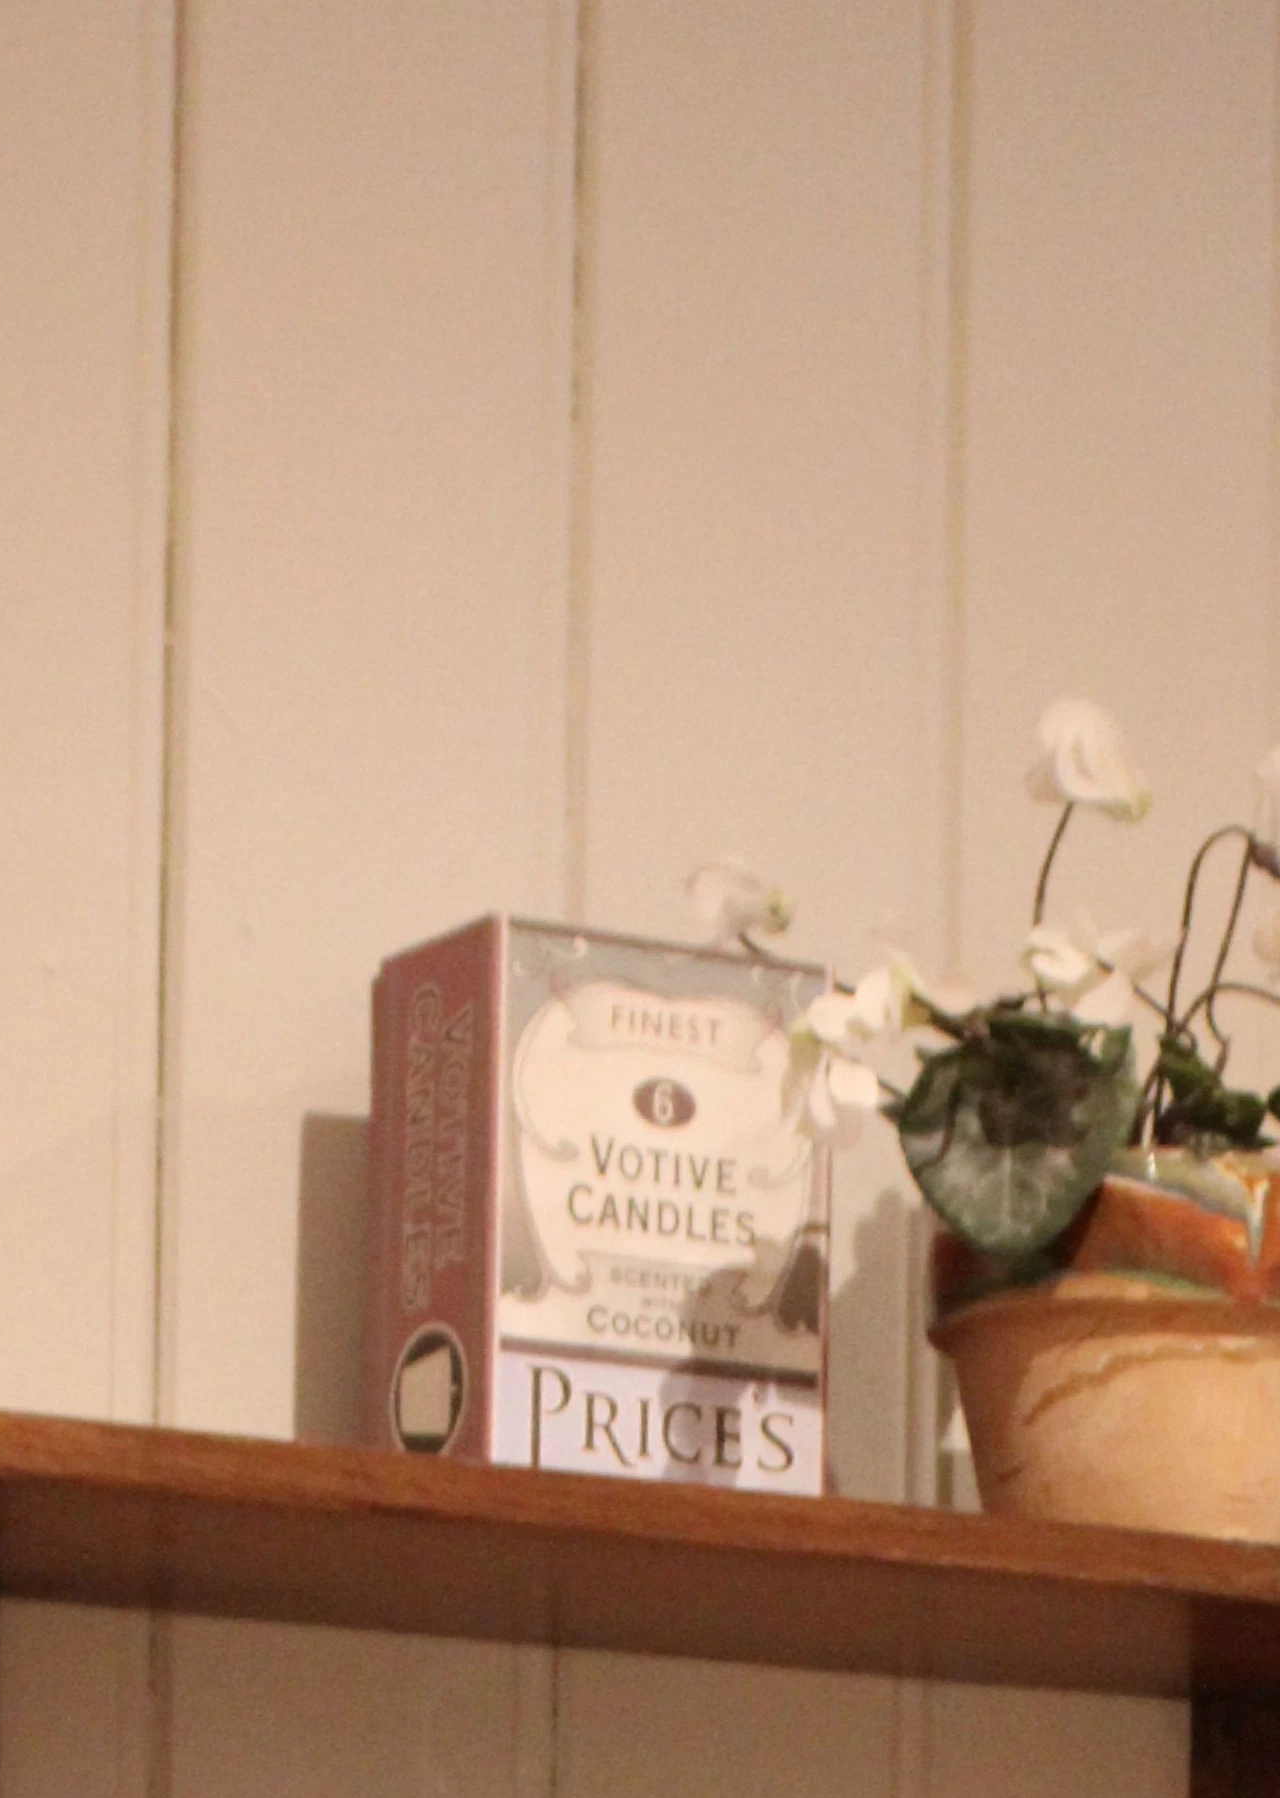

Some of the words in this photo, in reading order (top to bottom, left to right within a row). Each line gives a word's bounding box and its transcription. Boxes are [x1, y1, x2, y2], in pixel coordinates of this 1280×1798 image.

[609, 1003, 723, 1046] FINEST
[652, 1080, 674, 1128] 6
[590, 1132, 738, 1195] VOTIVE
[567, 1182, 756, 1246] CANDLES
[586, 1304, 741, 1349] COCONUT
